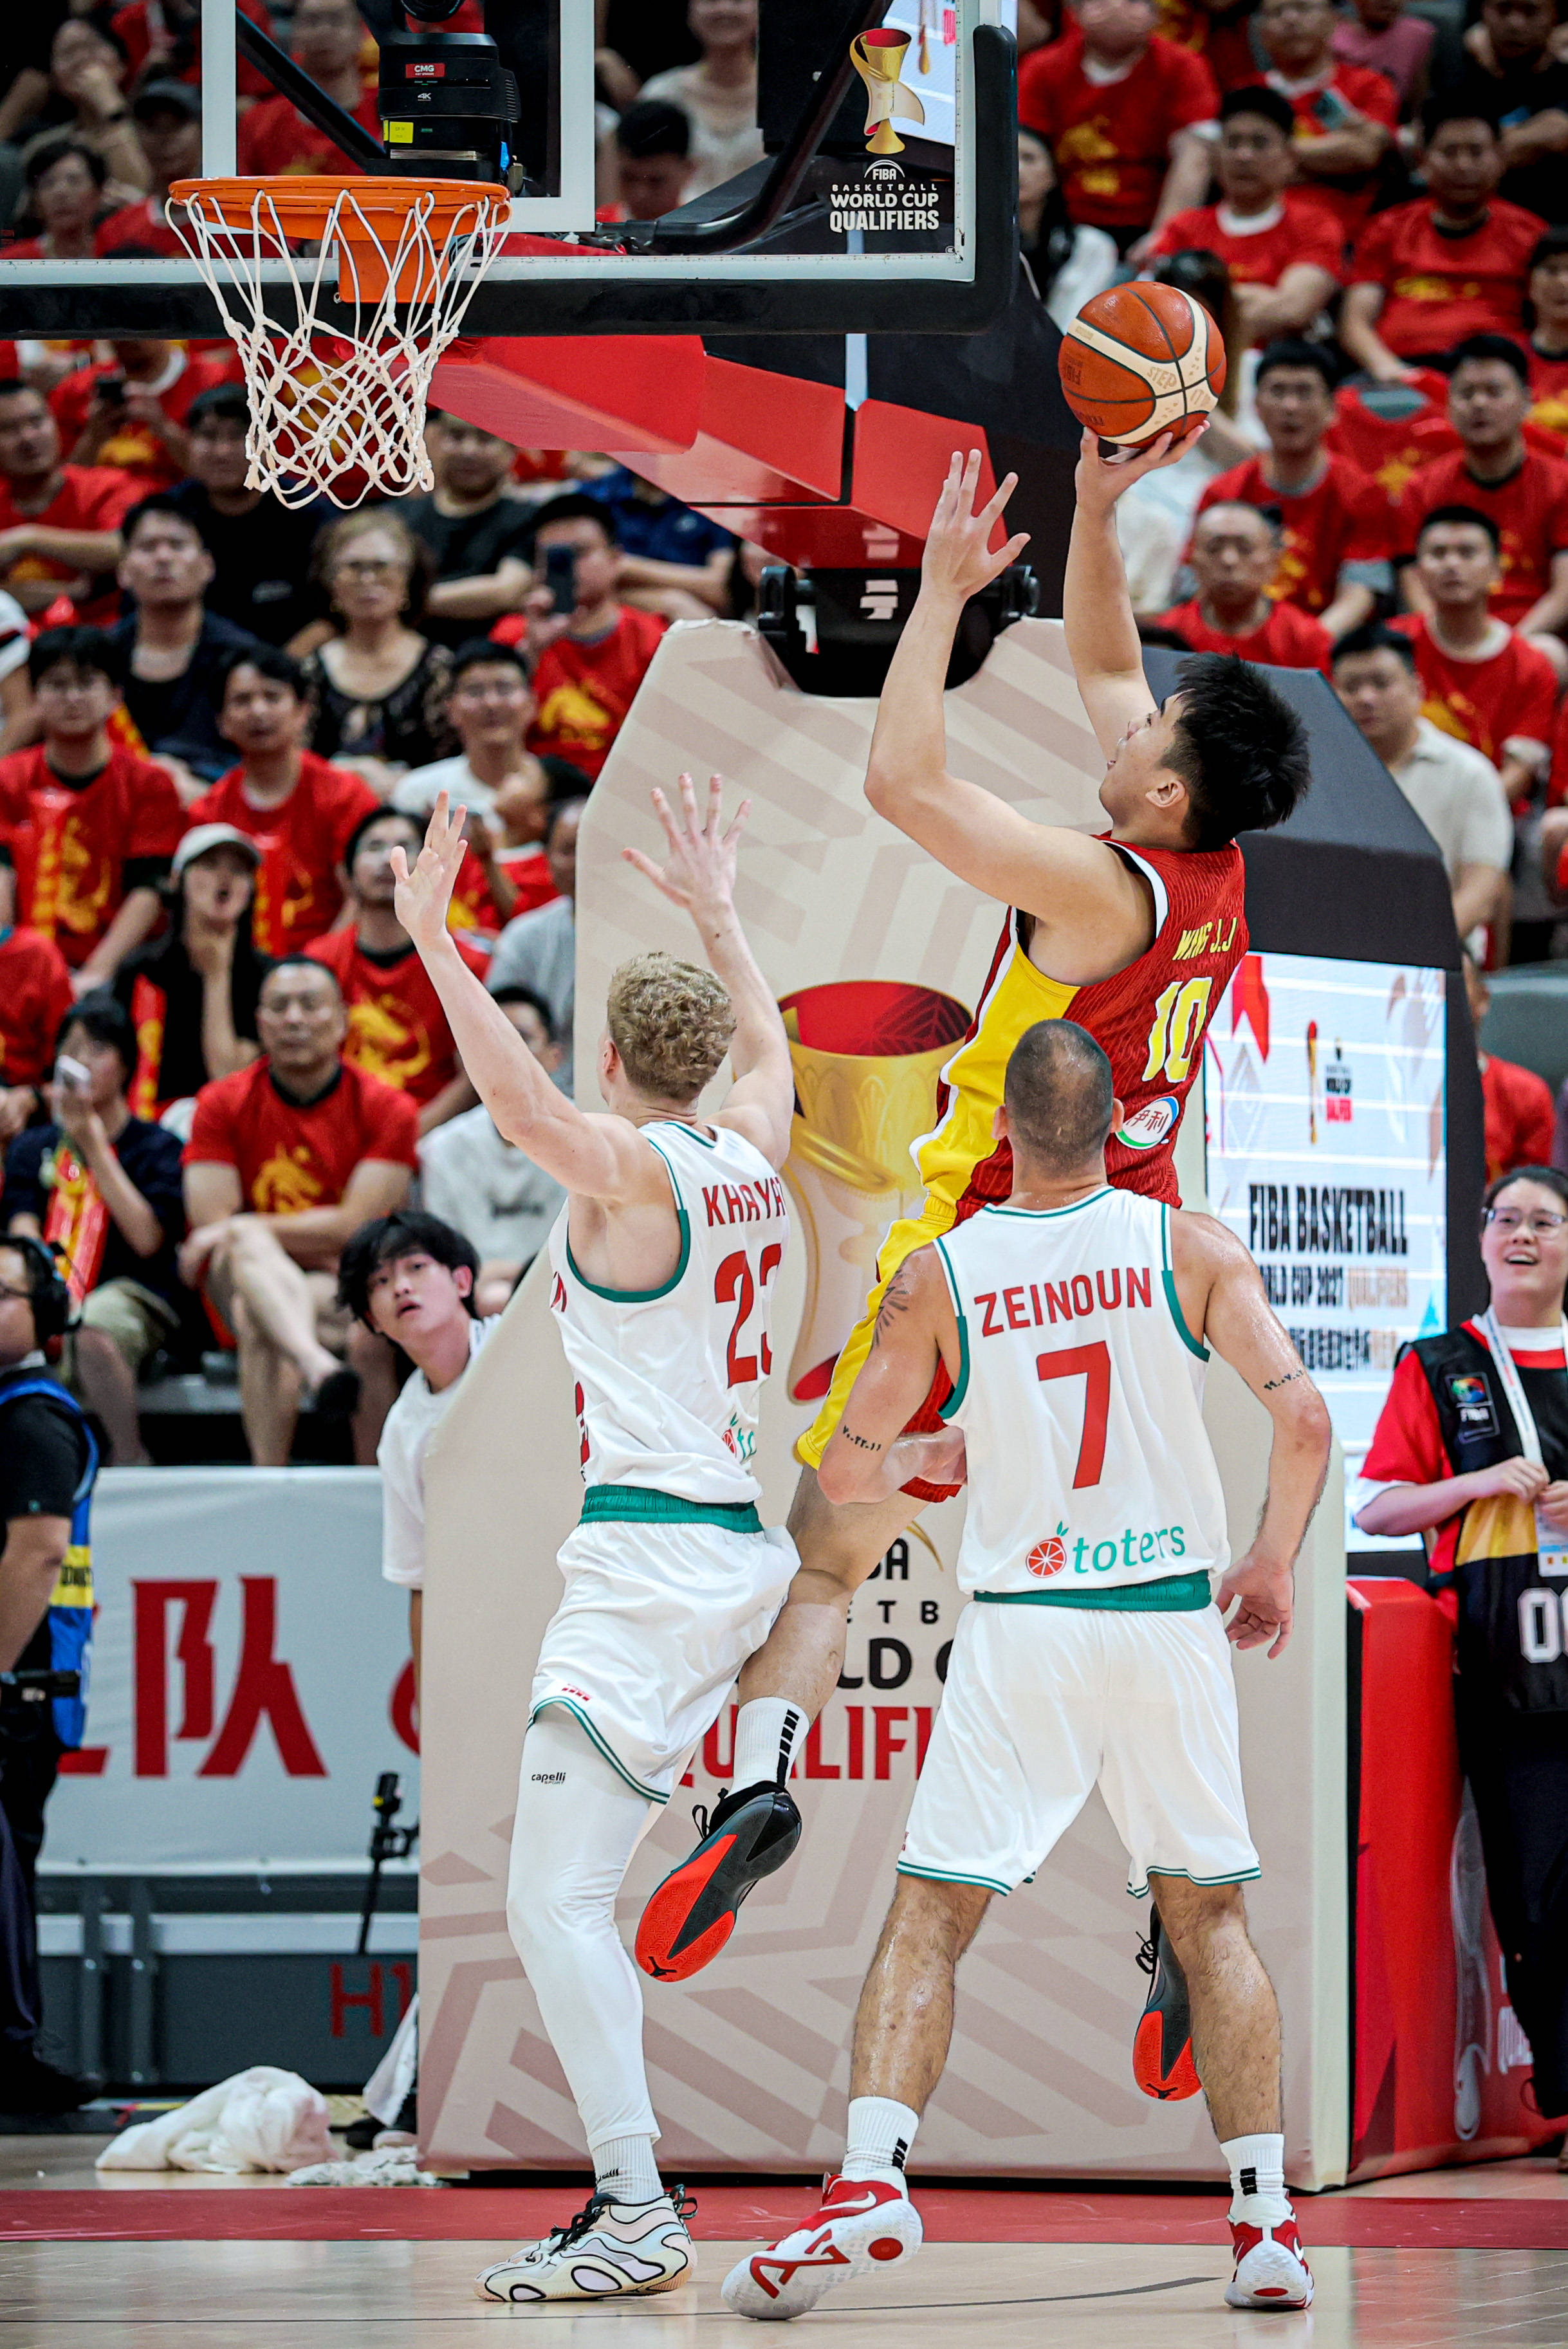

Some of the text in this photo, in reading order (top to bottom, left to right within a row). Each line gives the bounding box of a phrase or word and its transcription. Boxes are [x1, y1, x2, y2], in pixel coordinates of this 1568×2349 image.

[872, 169, 896, 180] FIBA
[832, 183, 937, 192] BASKETBALL
[831, 193, 939, 208] WORLD CUP
[830, 210, 939, 233] QUALIFIERS
[1147, 365, 1177, 390] STEP
[1141, 977, 1213, 1083] 10
[1126, 1109, 1168, 1134] 伊利
[1249, 1183, 1408, 1255] FIBA BASKETBALL
[973, 1267, 1152, 1337] ZEINOUN
[1036, 1340, 1111, 1489] 7
[1073, 1526, 1185, 1574] toters
[531, 1772, 566, 1783] capelli
